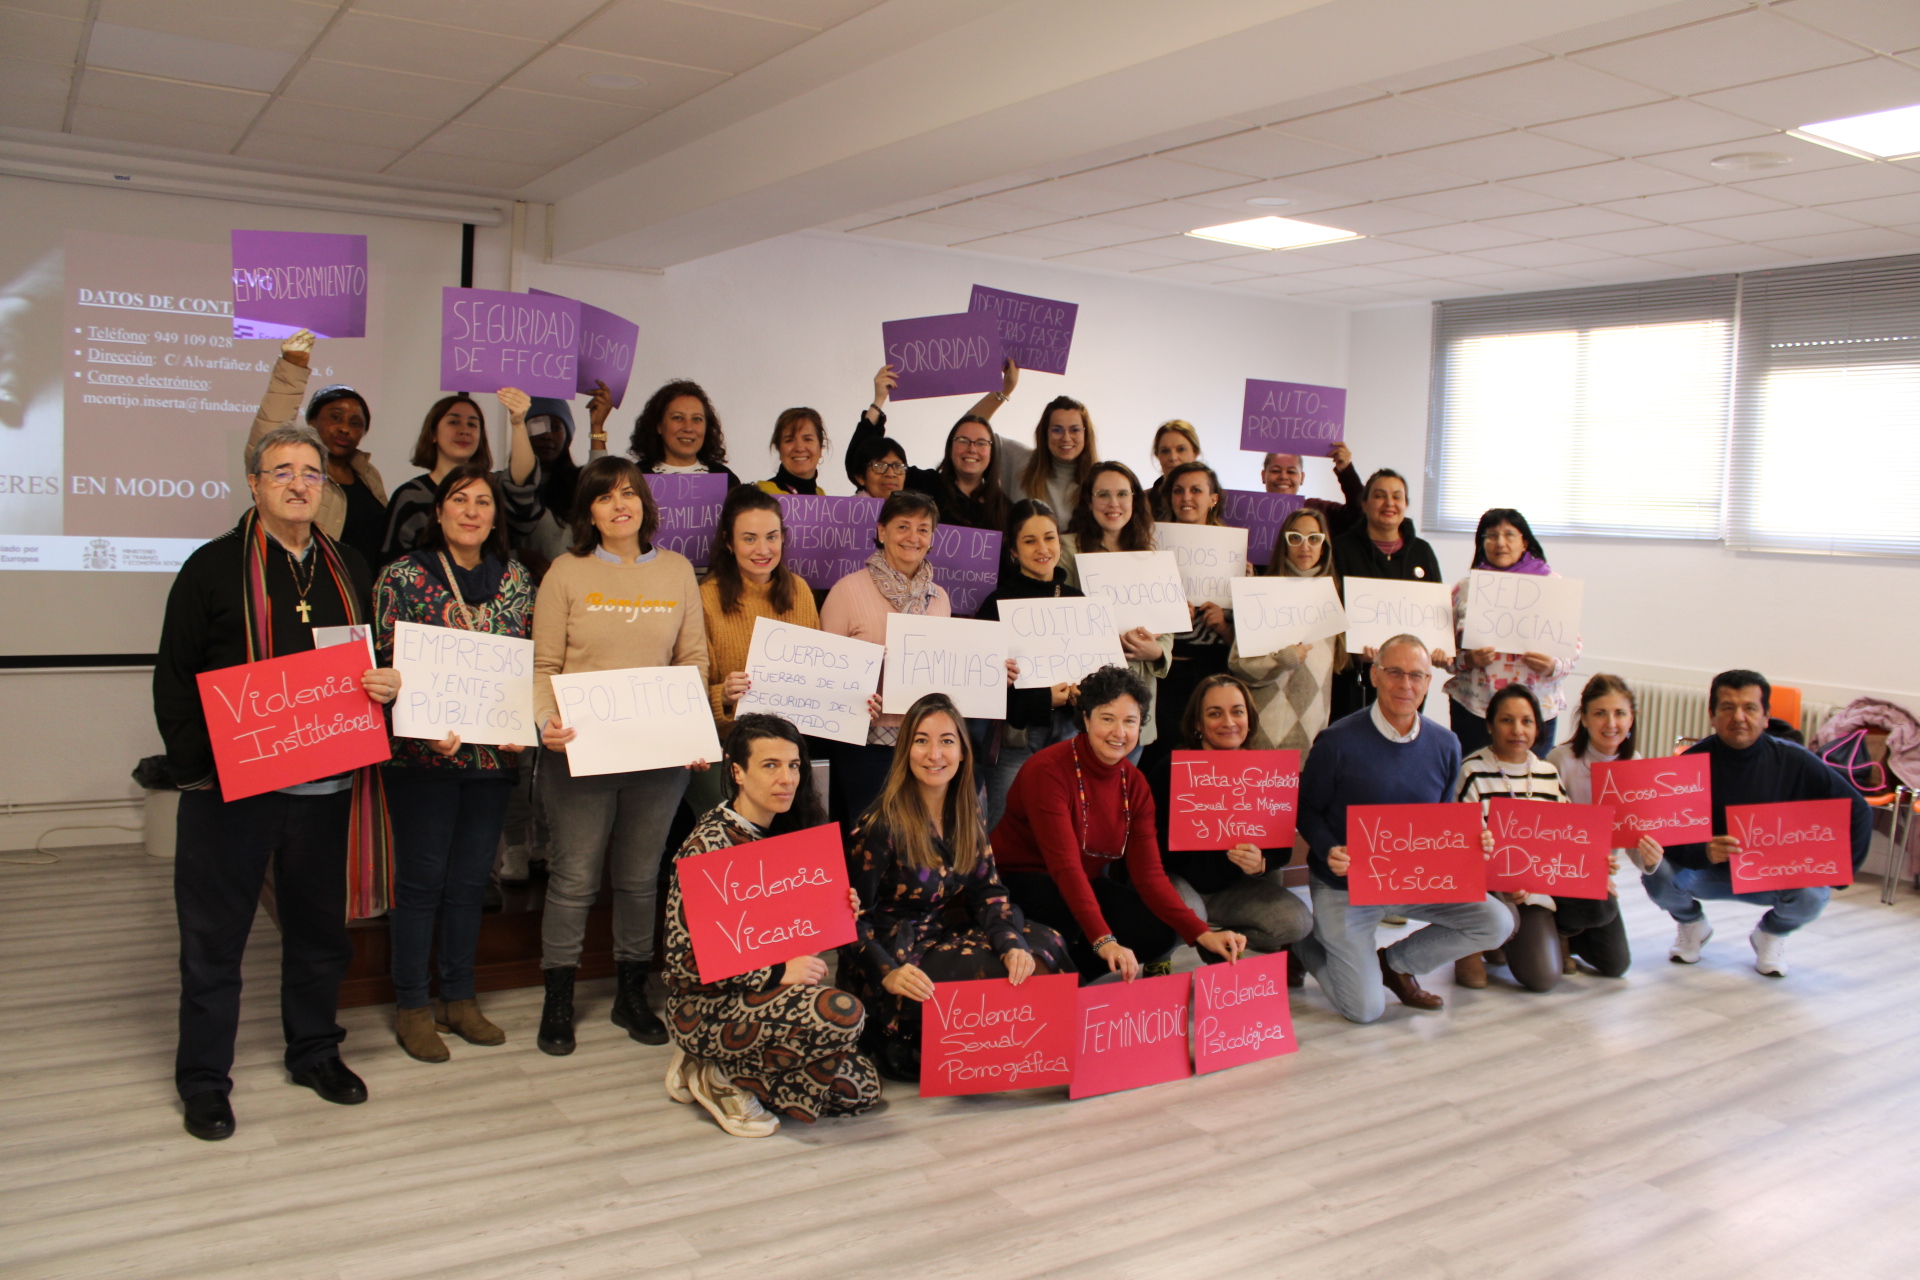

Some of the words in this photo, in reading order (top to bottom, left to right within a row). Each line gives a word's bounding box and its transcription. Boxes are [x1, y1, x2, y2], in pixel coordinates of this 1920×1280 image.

[234, 265, 365, 302] EMPODERAMIENTO
[79, 288, 144, 307] DATOS
[150, 294, 174, 310] DE
[179, 298, 234, 316] CONT
[973, 292, 1065, 327] IDENTIFICAR
[87, 325, 150, 344] Teléfono:
[154, 331, 179, 344] 949
[183, 333, 206, 346] 109
[209, 336, 233, 348] 028
[453, 301, 575, 349] SEGURIDAD
[997, 319, 1027, 343] ERAS
[1029, 326, 1071, 350] FASES
[88, 348, 157, 366] Dirección:
[164, 353, 181, 366] C/
[255, 360, 270, 373] de
[454, 346, 486, 373] DE
[501, 349, 575, 380] FFCCSE
[579, 330, 630, 371] NISMO
[889, 336, 990, 374] SORORIDAD
[87, 370, 134, 385] Correo
[137, 373, 212, 391] electrónico:
[326, 366, 334, 377] 6
[1261, 390, 1329, 414] AUTO-
[1247, 415, 1341, 440] PROTECCIÓN
[72, 475, 106, 495] EN
[115, 477, 194, 498] MODO
[201, 480, 231, 500] ON
[678, 475, 702, 500] DE
[1224, 494, 1300, 524] UCACIÓN
[657, 535, 716, 561] SOCIA
[971, 532, 996, 560] DE
[1229, 551, 1242, 563] DE
[823, 560, 834, 579] Y
[585, 592, 678, 623] Bonjour
[1475, 573, 1541, 611] RED
[1012, 603, 1116, 637] CULTURA
[1353, 594, 1449, 631] SANIDAD
[1477, 609, 1573, 646] SOCIAL
[402, 629, 524, 677] EMPRESAS
[764, 628, 849, 669] CUERPOS
[865, 659, 875, 675] Y
[902, 634, 1001, 688] FAMILIAS
[1060, 637, 1070, 654] Y
[430, 671, 441, 689] Y
[445, 674, 505, 703] ENTES
[752, 665, 806, 685] FUERZAS
[815, 678, 836, 690] DE
[842, 682, 860, 690] LA
[213, 671, 358, 724] Violencia
[745, 691, 820, 710] SEGURIDAD
[828, 702, 858, 716] DEL
[233, 701, 381, 764] Institucional
[1171, 762, 1232, 788] Trata
[1232, 778, 1247, 796] y
[1599, 769, 1657, 805] Acoso
[1654, 772, 1704, 797] Sexual
[1177, 794, 1228, 813] Sexual
[1233, 796, 1252, 811] de
[1257, 797, 1292, 816] Mujeres
[1624, 814, 1667, 831] Razón
[1667, 812, 1681, 827] de
[1680, 809, 1710, 828] Sexo
[1216, 814, 1267, 842] Niñas
[1358, 817, 1470, 853] Violencia
[1497, 810, 1591, 844] Violencia
[1734, 813, 1836, 848] Violencia
[1493, 845, 1590, 885] Digital
[1736, 850, 1838, 881] Económica
[702, 860, 832, 905] Violencia
[716, 911, 820, 954] Vicaria
[1201, 972, 1279, 1010] Violencia
[931, 989, 1035, 1031] Violencia
[1197, 1016, 1285, 1057] Psicológica
[939, 1051, 1070, 1084] Pornográfica
